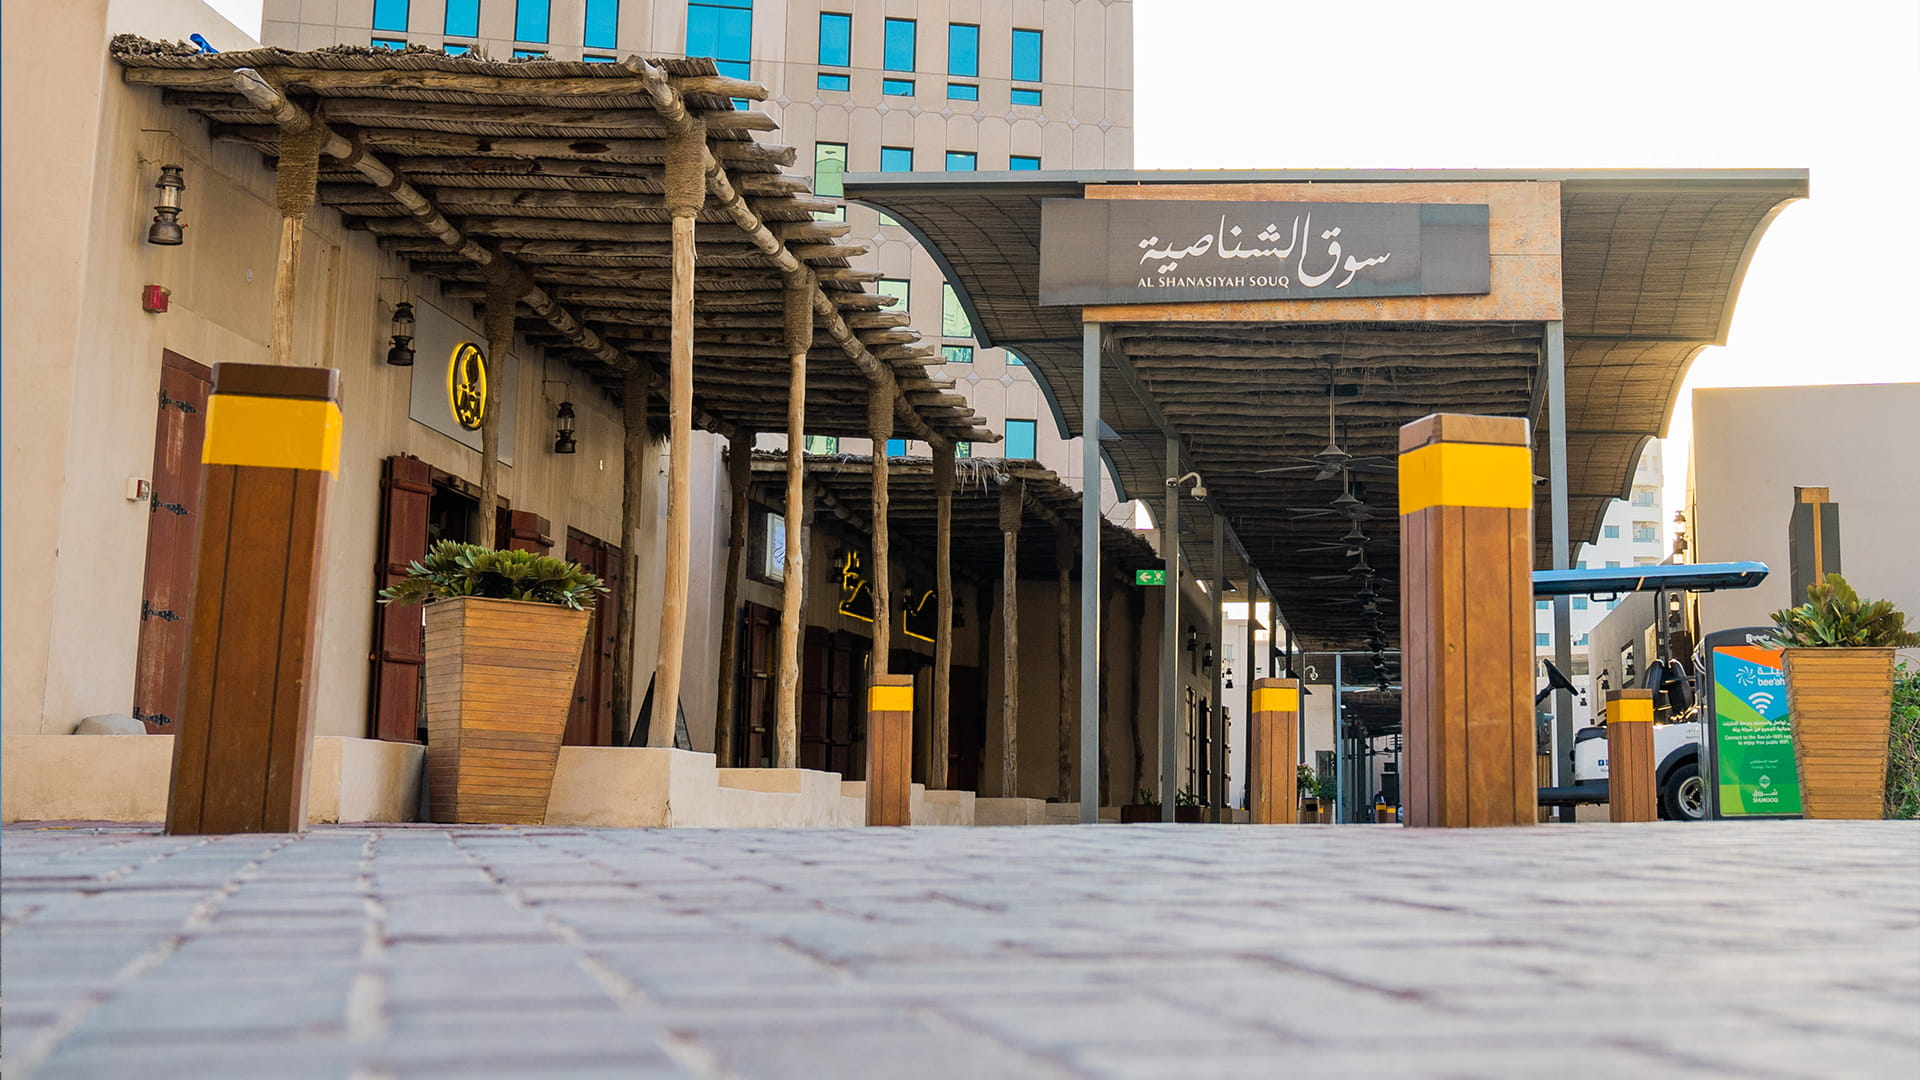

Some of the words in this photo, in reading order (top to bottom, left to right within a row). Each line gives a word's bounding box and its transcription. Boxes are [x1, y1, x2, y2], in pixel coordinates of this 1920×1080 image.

[1138, 211, 1311, 275] الشناصية
[1298, 225, 1391, 289] سوق
[1137, 276, 1154, 288] AL
[1158, 275, 1245, 288] SHANASIYAH
[1249, 275, 1290, 289] SOUQ
